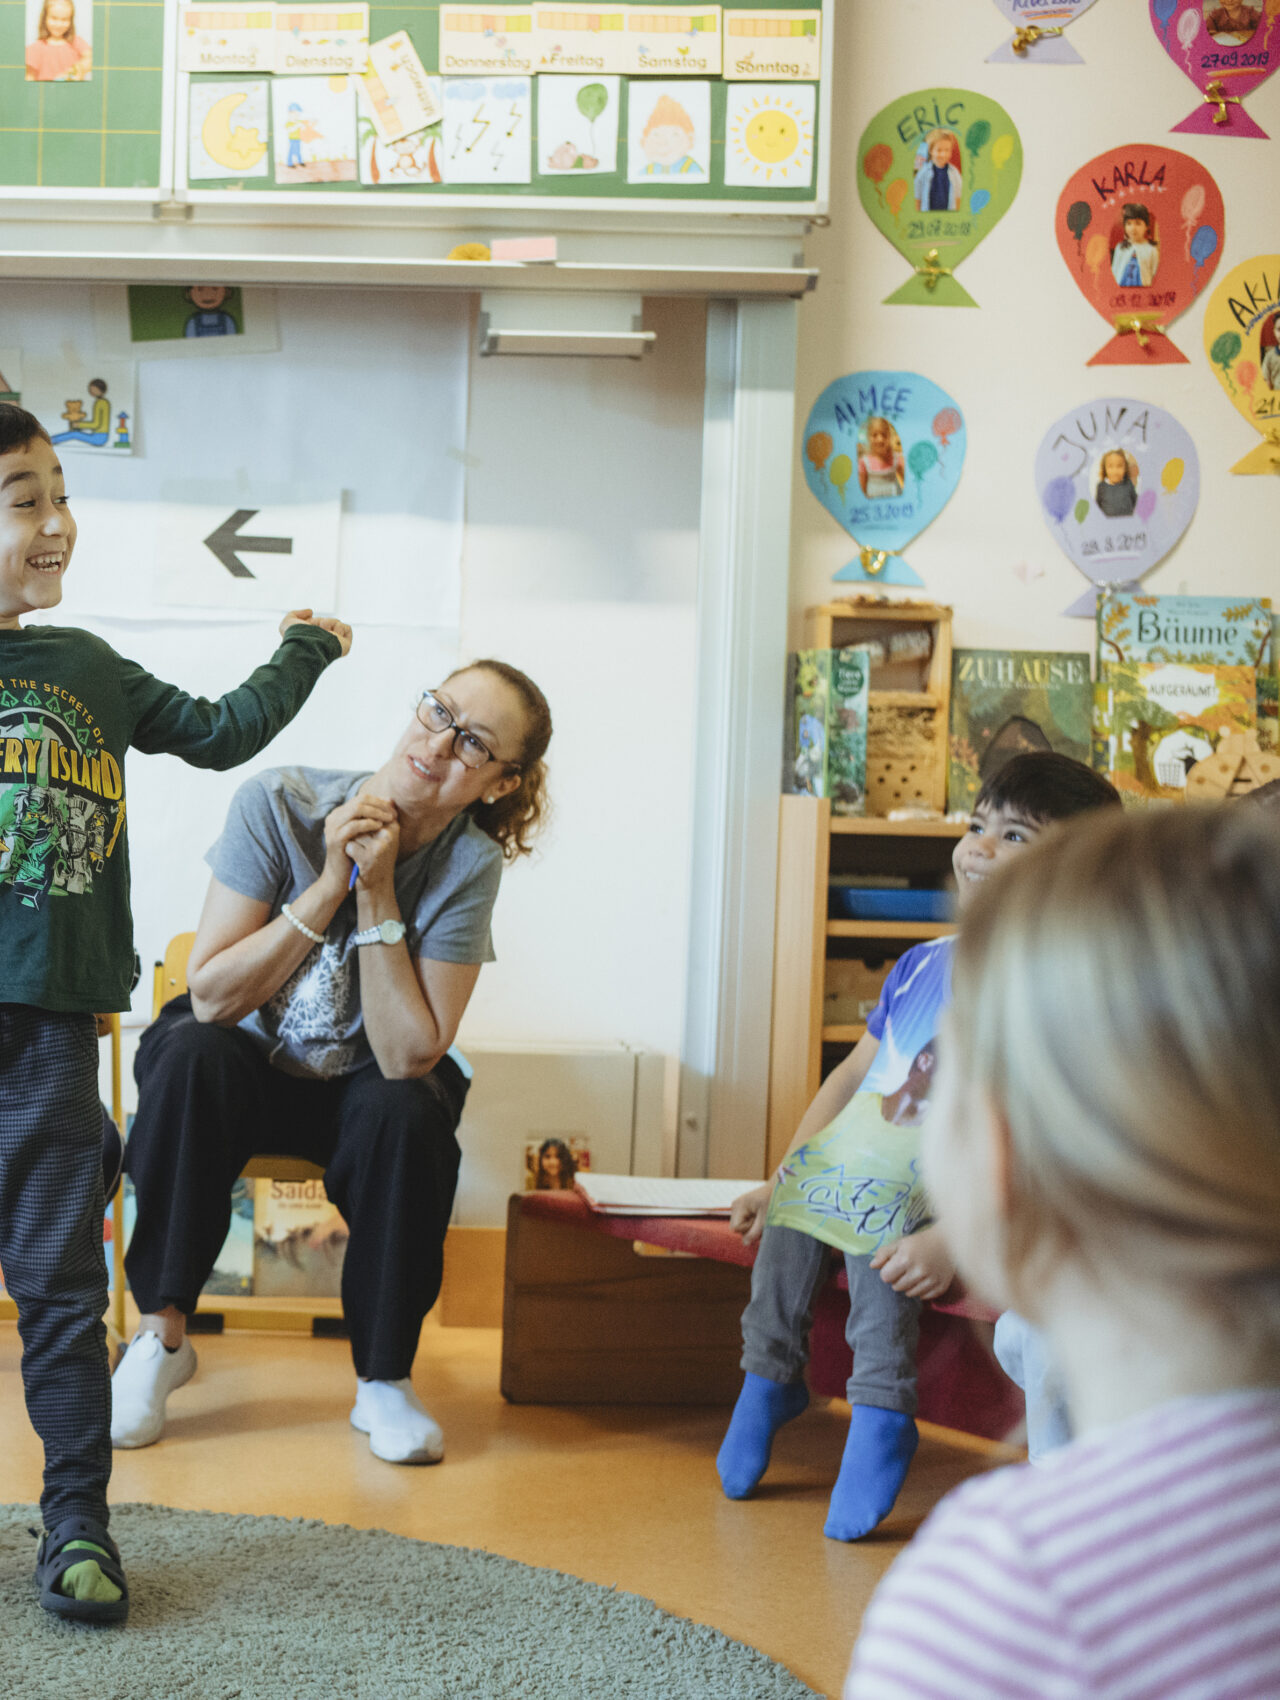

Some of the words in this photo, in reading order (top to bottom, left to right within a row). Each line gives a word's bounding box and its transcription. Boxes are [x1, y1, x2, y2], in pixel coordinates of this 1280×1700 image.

[199, 52, 257, 66] Montag
[286, 54, 353, 68] Dienstag
[445, 54, 531, 70] Donnerstag
[550, 53, 604, 69] Freitag
[638, 54, 707, 69] Samstag
[735, 60, 800, 74] Sonntag
[1092, 161, 1166, 200] KARLA
[1228, 272, 1280, 328] AKI
[1052, 405, 1150, 479] JUNA
[1138, 609, 1238, 646] Bäume
[959, 658, 1084, 684] ZUHAUSE
[10, 678, 37, 690] THE
[43, 683, 94, 724] SECRETS
[92, 727, 105, 747] OF
[50, 739, 122, 801] ISLAND
